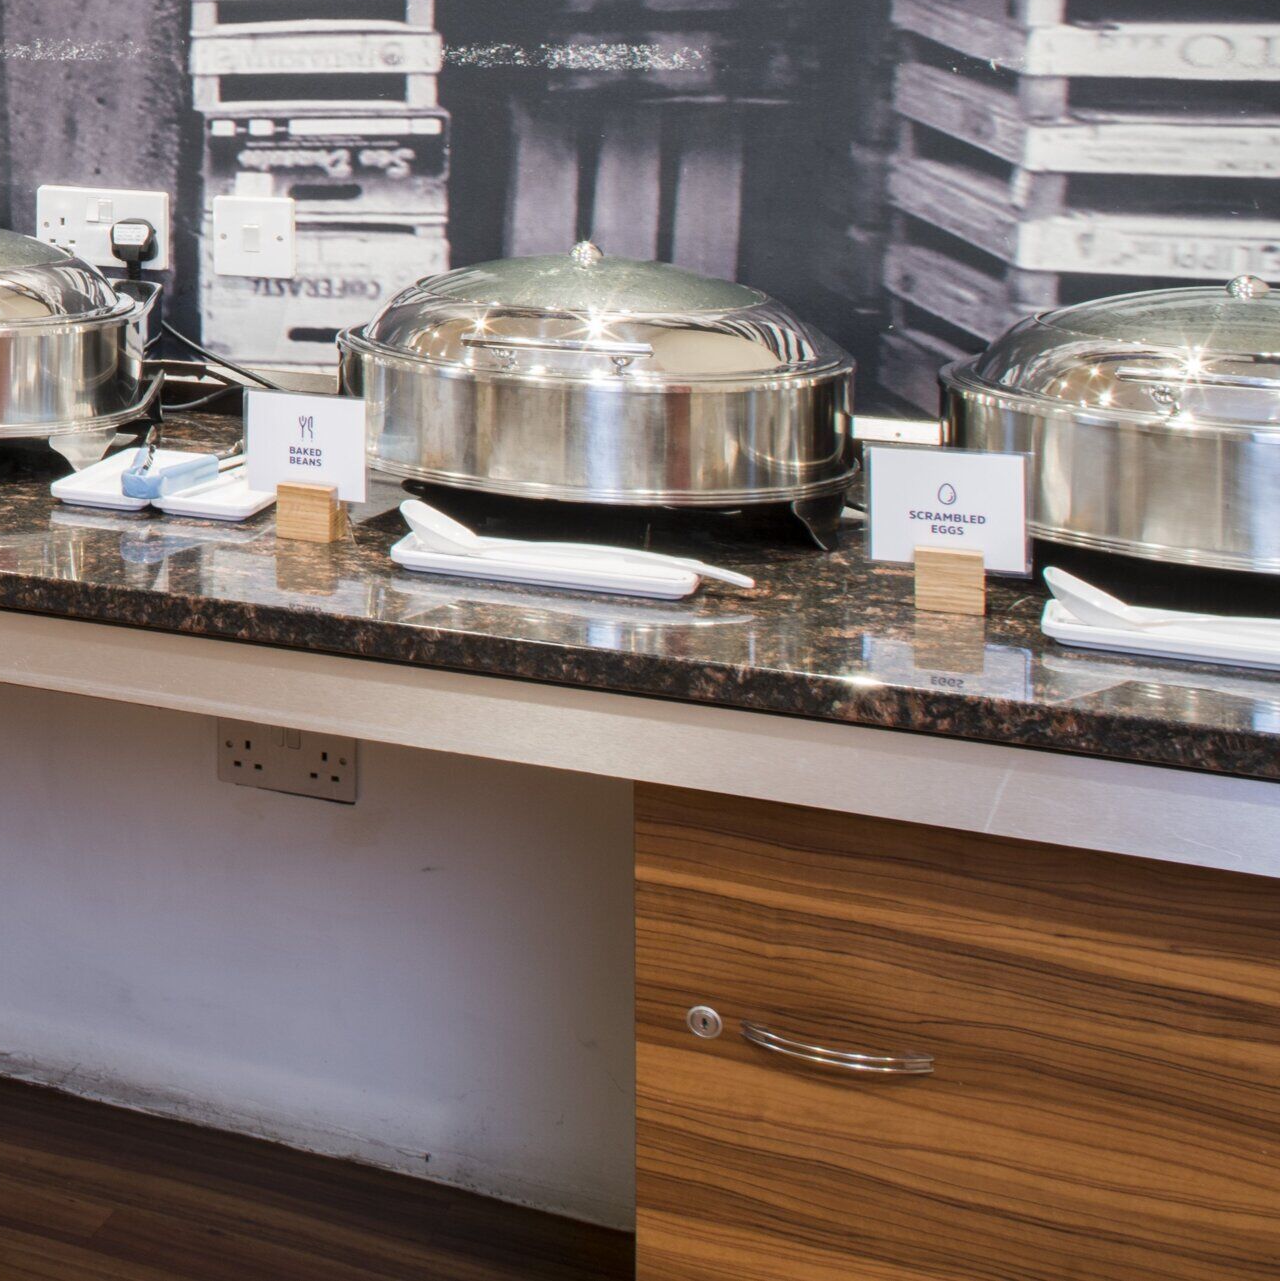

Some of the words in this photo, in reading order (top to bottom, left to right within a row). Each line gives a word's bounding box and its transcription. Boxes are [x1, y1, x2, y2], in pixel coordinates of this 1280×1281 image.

[289, 445, 323, 457] BAKED
[289, 455, 322, 467] BEANS
[909, 509, 987, 525] SCRAMBLED
[930, 524, 965, 536] EGGS
